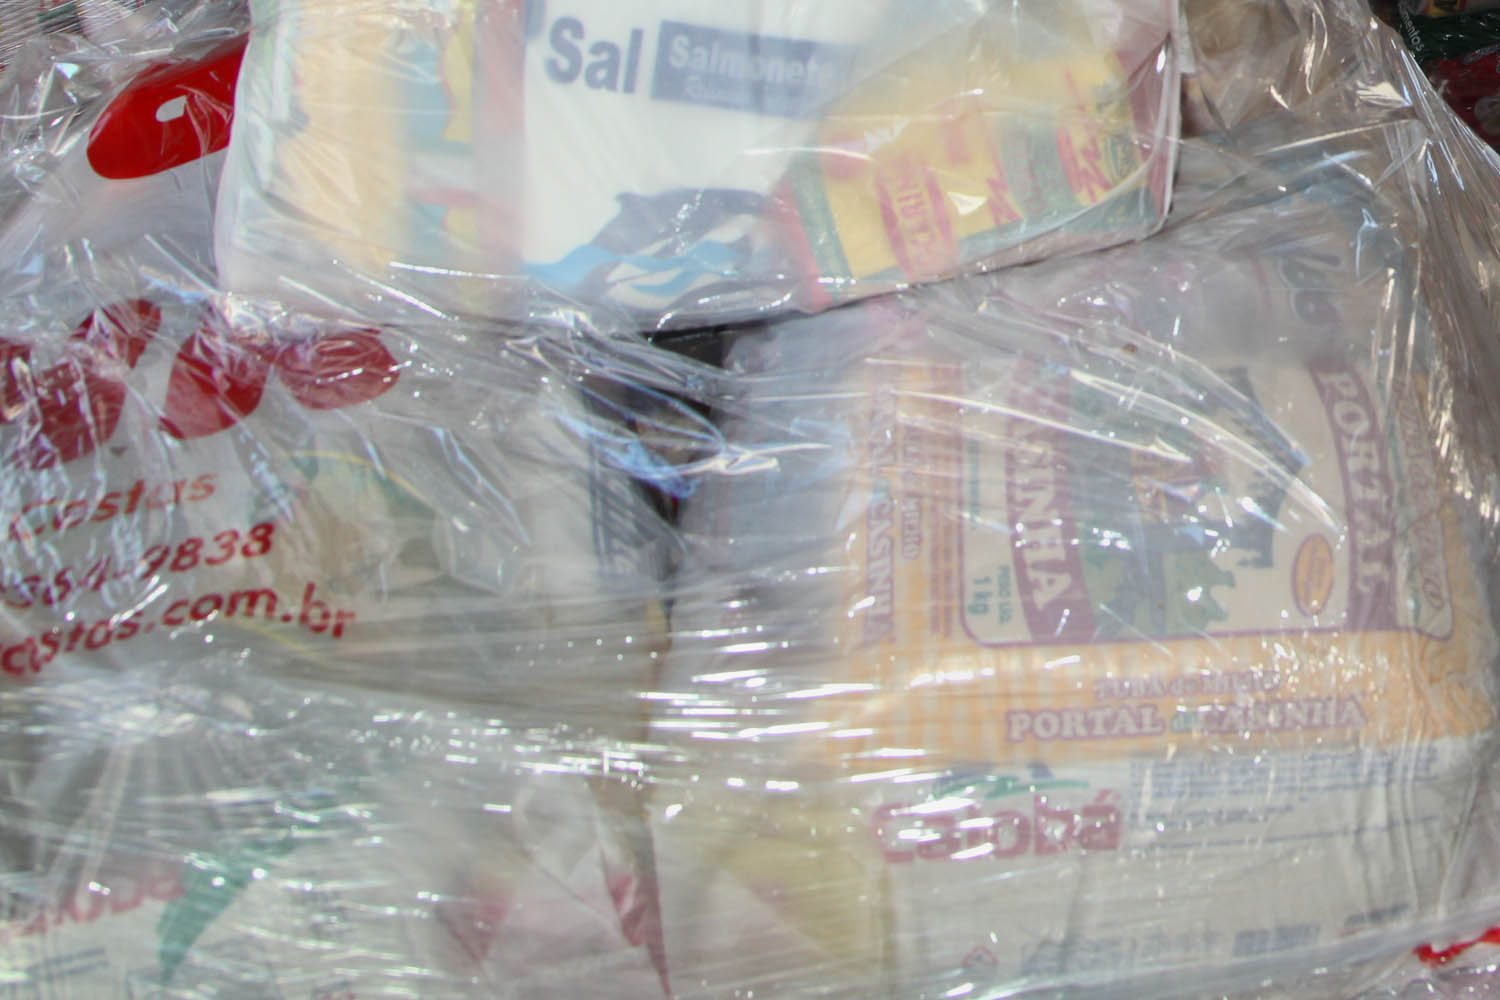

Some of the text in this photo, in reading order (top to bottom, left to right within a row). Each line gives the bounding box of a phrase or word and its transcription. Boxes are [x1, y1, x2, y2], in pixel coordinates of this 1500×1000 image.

[543, 15, 838, 94] Sal Salmonete
[1321, 370, 1391, 594] PORTAL
[1005, 704, 1166, 742] PORTAL
[1198, 698, 1368, 735] CASINHA
